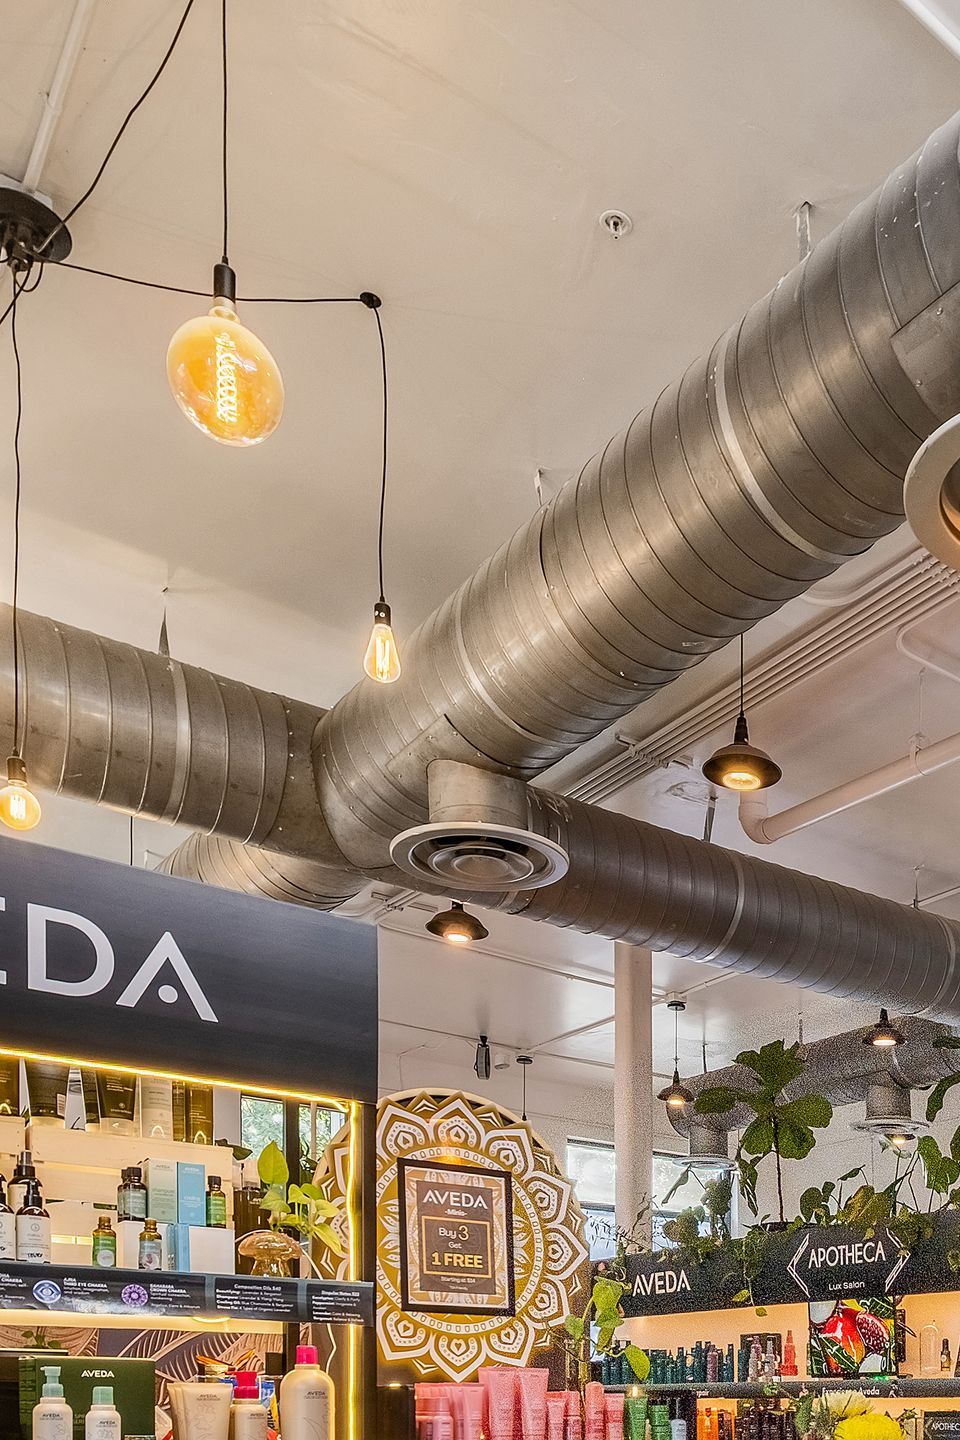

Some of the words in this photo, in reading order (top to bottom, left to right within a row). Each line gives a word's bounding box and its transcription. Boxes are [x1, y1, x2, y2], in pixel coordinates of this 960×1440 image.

[0, 896, 219, 1023] DA
[422, 1189, 489, 1209] AVEDA
[438, 1227, 457, 1239] Buy
[458, 1225, 469, 1241] 3
[448, 1241, 463, 1249] Get
[431, 1251, 441, 1266] 1
[444, 1252, 483, 1269] FREE
[808, 1240, 886, 1270] APOTHECA
[632, 1269, 691, 1297] AVEDA
[828, 1283, 842, 1291] Lux
[843, 1281, 865, 1290] Salon
[81, 1369, 115, 1378] AVEDA
